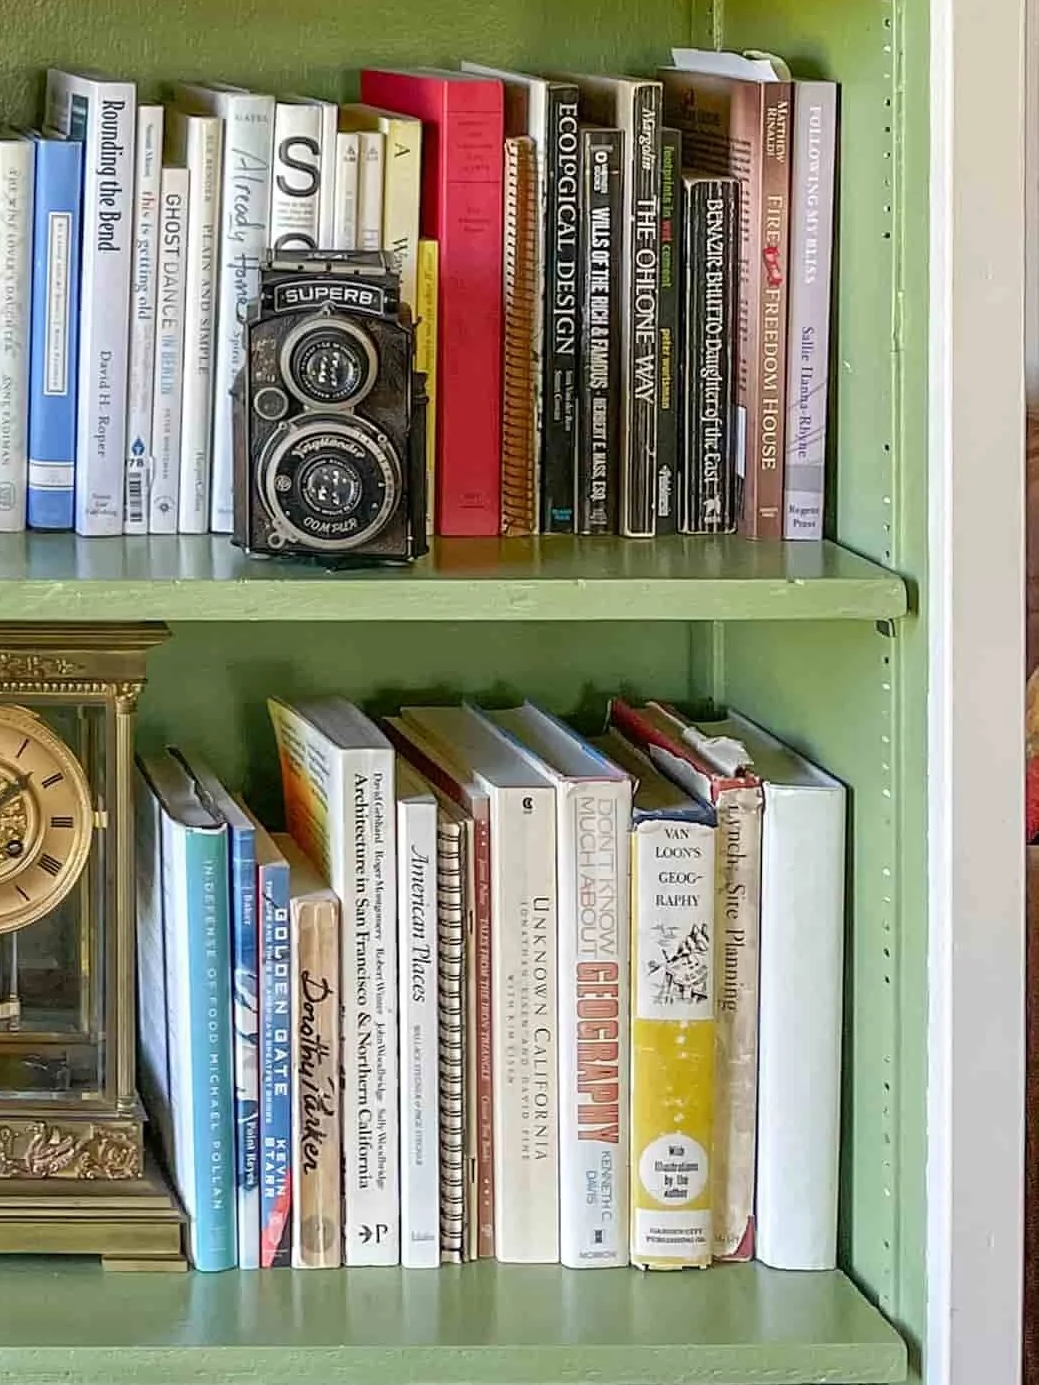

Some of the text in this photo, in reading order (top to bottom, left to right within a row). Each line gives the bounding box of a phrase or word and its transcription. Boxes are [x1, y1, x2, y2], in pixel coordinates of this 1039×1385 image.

[162, 193, 182, 329] GHOST DANCE
[225, 149, 267, 318] Already Home
[552, 102, 578, 355] ECOLOGICAL DESIGN
[704, 198, 724, 267] BENAZIR
[94, 100, 126, 457] Rounding the Bend David H. Roper
[284, 286, 373, 306] SUPERB
[635, 196, 657, 404] THE OHLONE WAY
[701, 339, 723, 407] Daughter
[761, 195, 782, 471] FIRE FREEDOM HOUSE
[703, 407, 721, 424] of
[704, 425, 721, 449] the
[703, 451, 720, 482] East
[655, 845, 703, 860] LOON'S
[663, 828, 690, 841] VAN
[655, 894, 701, 909] RAPHY
[658, 870, 706, 885] GEOG-
[727, 882, 747, 919] Site
[410, 844, 430, 1003] American Places
[354, 773, 372, 1189] Architecture in San Francisco & Northern California
[722, 927, 746, 1012] Planning
[532, 896, 552, 1161] UNKNOWN CALIFORNIA
[575, 961, 620, 1144] GEOGRAPHY
[298, 970, 335, 1176] Dorothy Parker
